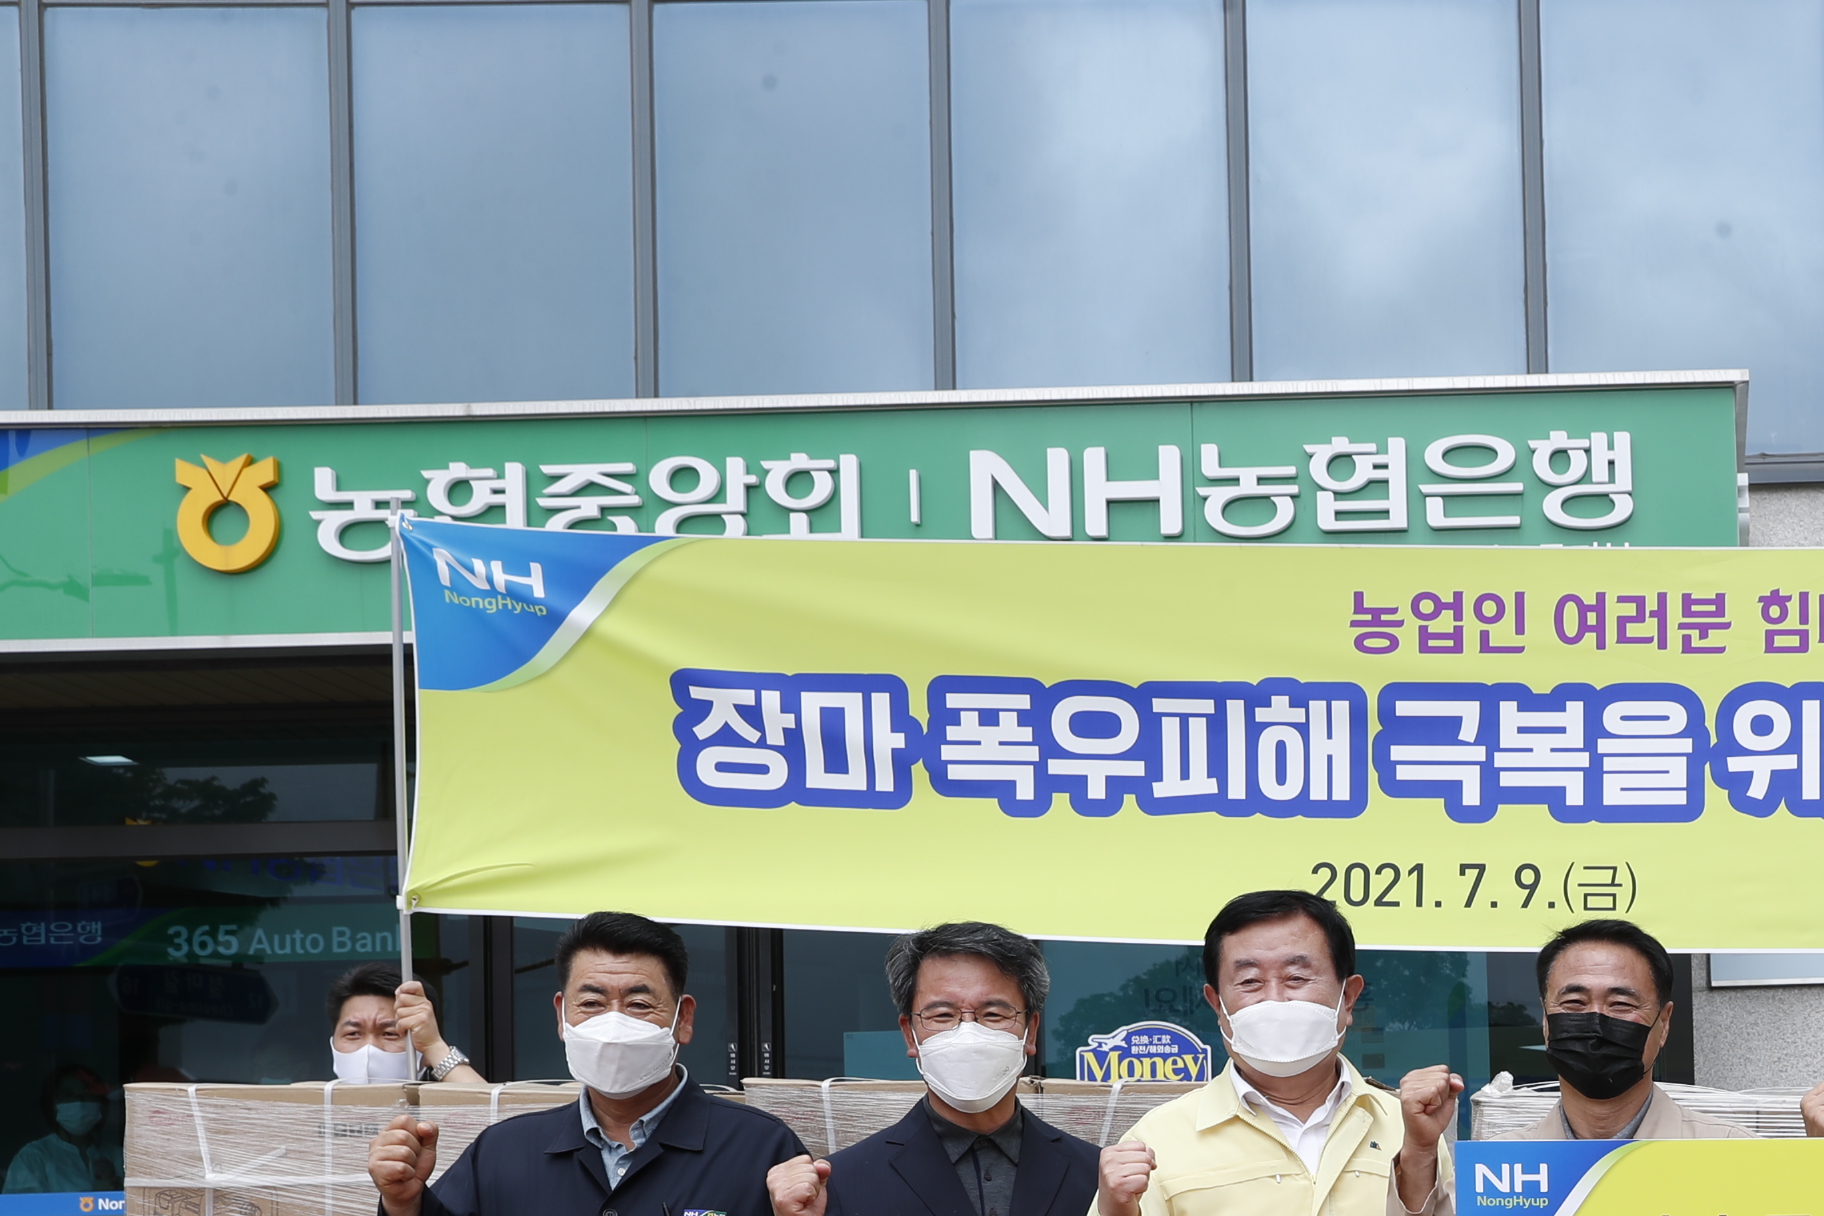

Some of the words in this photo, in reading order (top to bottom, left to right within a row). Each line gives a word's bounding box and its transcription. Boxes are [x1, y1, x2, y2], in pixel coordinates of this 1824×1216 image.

[969, 429, 1635, 541] NH농협은행
[434, 547, 546, 599] NH
[444, 590, 547, 617] NongHyup
[1349, 591, 1527, 655] 농업인
[1554, 591, 1732, 655] 여러분
[688, 683, 906, 793] 장마
[939, 691, 1352, 801] 폭우피해
[1389, 699, 1694, 807] 극복을
[167, 925, 239, 957] 365
[248, 926, 325, 956] Auto
[1080, 1050, 1206, 1082] Money
[1474, 1163, 1549, 1193] NH
[1476, 1194, 1549, 1209] NongHyup
